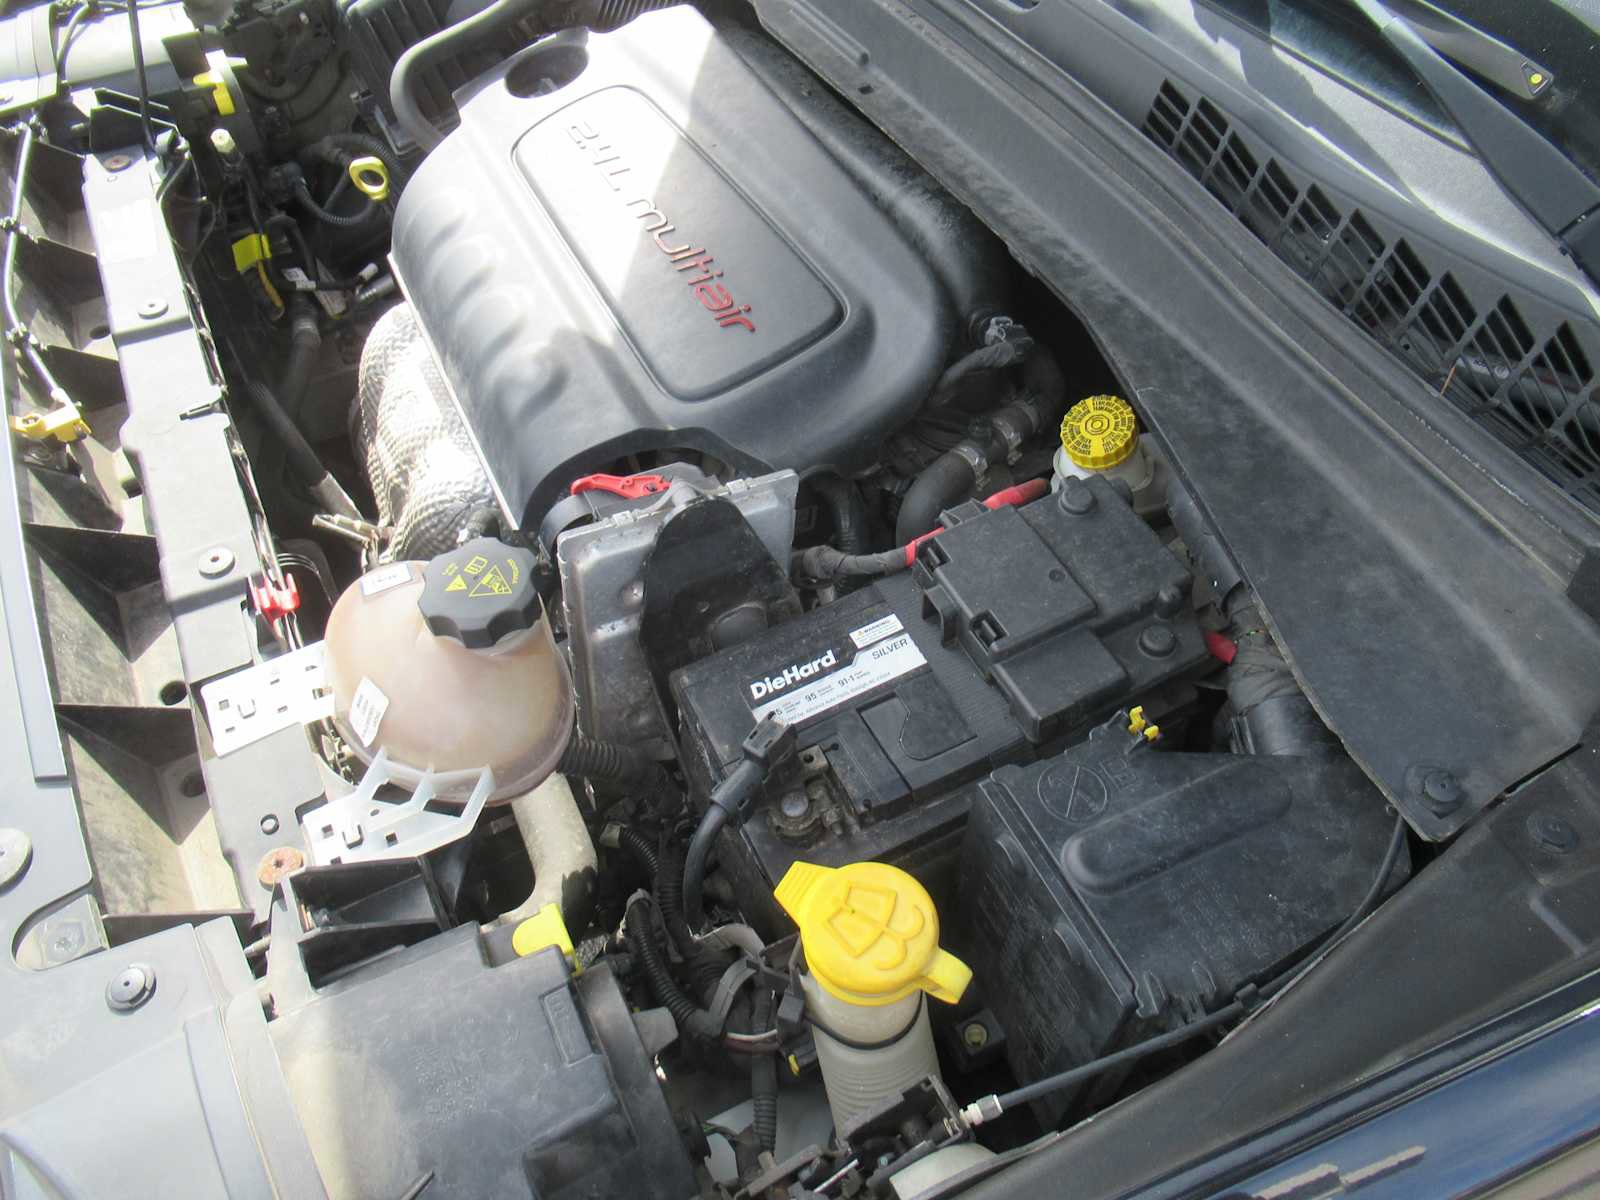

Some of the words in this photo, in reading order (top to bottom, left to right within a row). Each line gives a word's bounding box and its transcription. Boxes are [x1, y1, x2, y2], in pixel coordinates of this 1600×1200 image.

[625, 198, 756, 333] multiair
[872, 638, 908, 660] SILVER
[750, 650, 838, 700] DieHard
